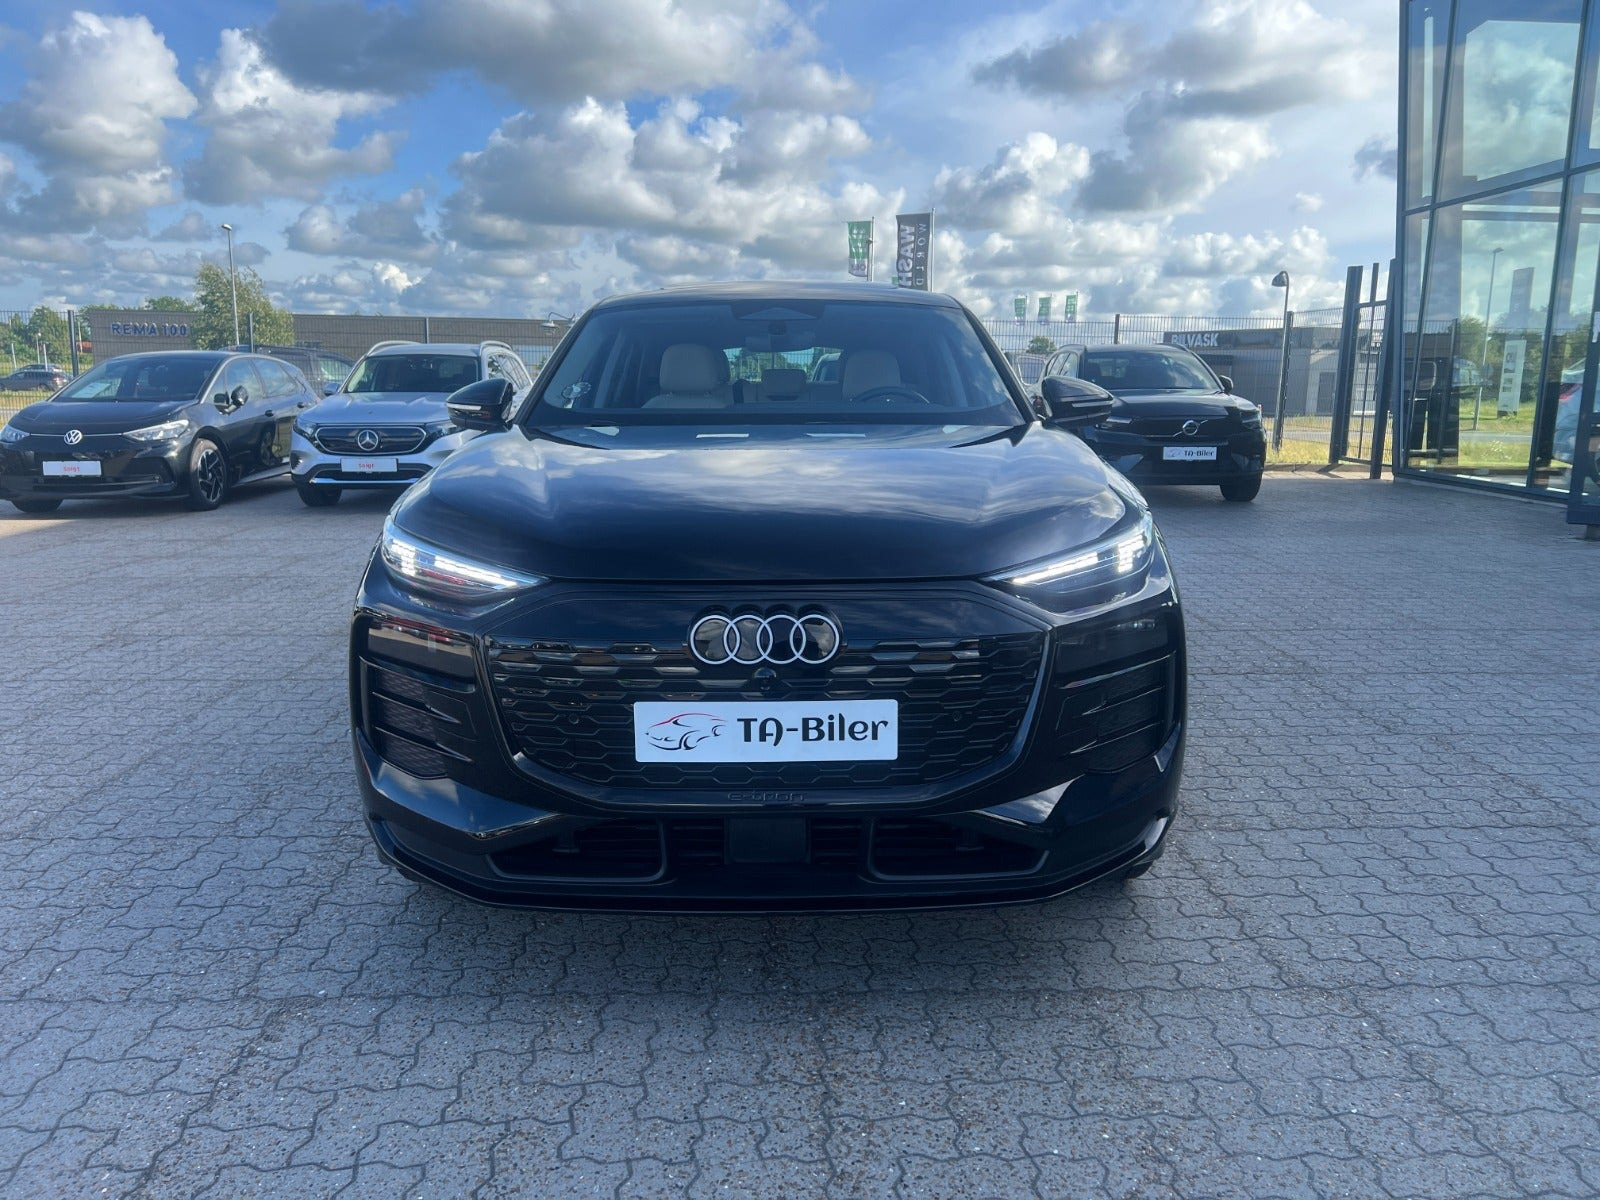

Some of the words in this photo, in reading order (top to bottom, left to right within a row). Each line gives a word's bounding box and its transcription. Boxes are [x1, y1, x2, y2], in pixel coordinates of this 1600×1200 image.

[111, 323, 157, 335] REMA
[162, 324, 187, 336] 100
[736, 712, 889, 747] TA-Biler
